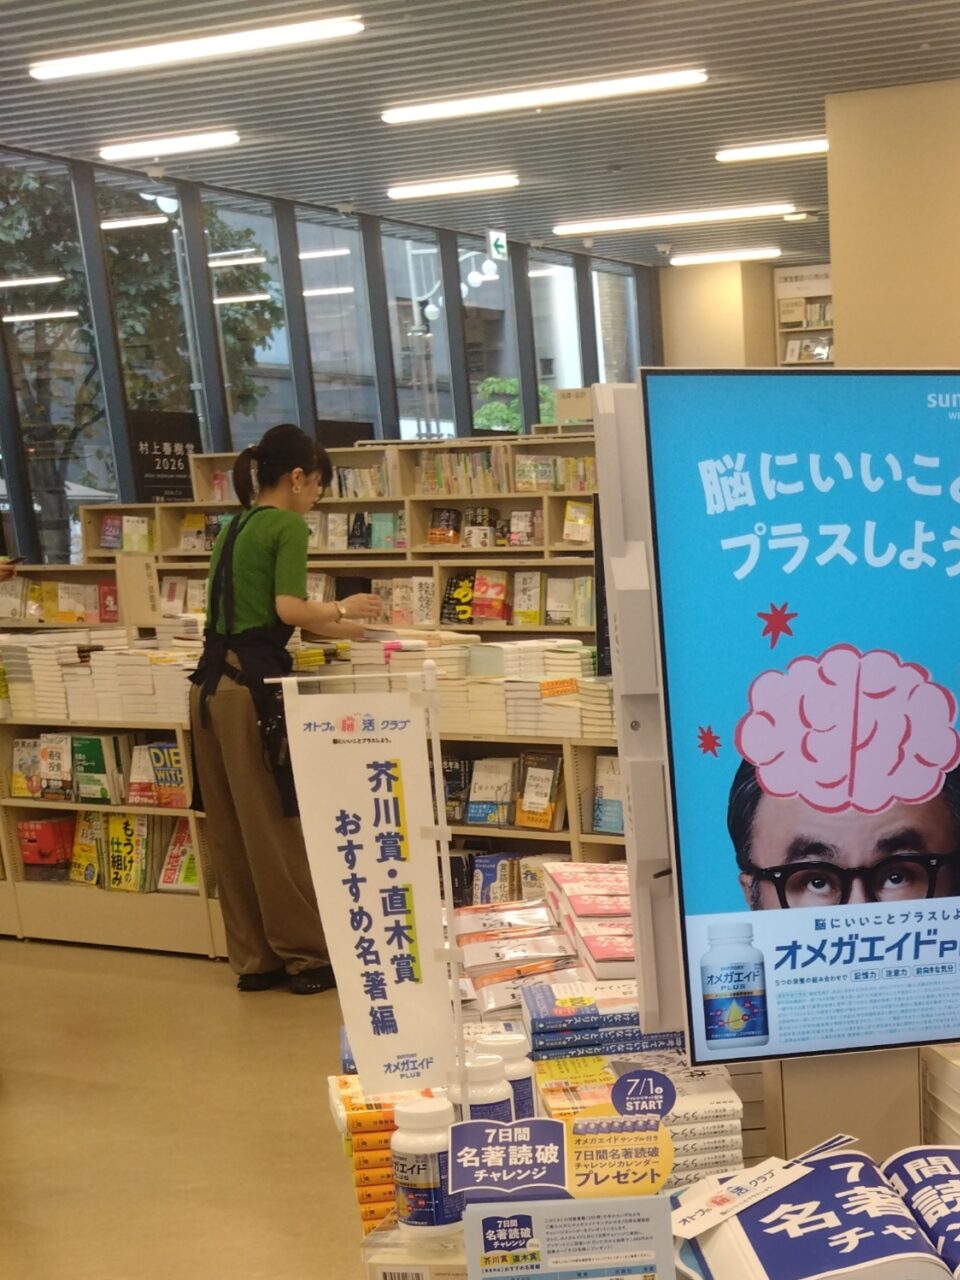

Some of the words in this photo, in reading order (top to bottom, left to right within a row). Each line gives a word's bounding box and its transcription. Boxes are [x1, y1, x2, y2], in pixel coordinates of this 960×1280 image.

[154, 458, 185, 470] 2026
[110, 837, 123, 886] 仕組み
[366, 760, 420, 985] 芥川賞・直木賞
[335, 808, 398, 1037] おすすめ名著編
[384, 1056, 434, 1075] オメガエイド
[626, 1099, 664, 1112] START
[484, 1127, 530, 1143] 7日間
[457, 1143, 560, 1168] 名著読破
[574, 1146, 659, 1161] 7日間名著読破
[574, 1159, 659, 1170] チャレンジカレンダー
[474, 1166, 547, 1183] チャレンジ
[576, 1168, 661, 1188] プレゼント
[496, 1218, 518, 1228] 7日間
[485, 1226, 532, 1241] 名著読破
[493, 1238, 526, 1249] チャレンジ
[483, 1255, 509, 1266] 芥川賞
